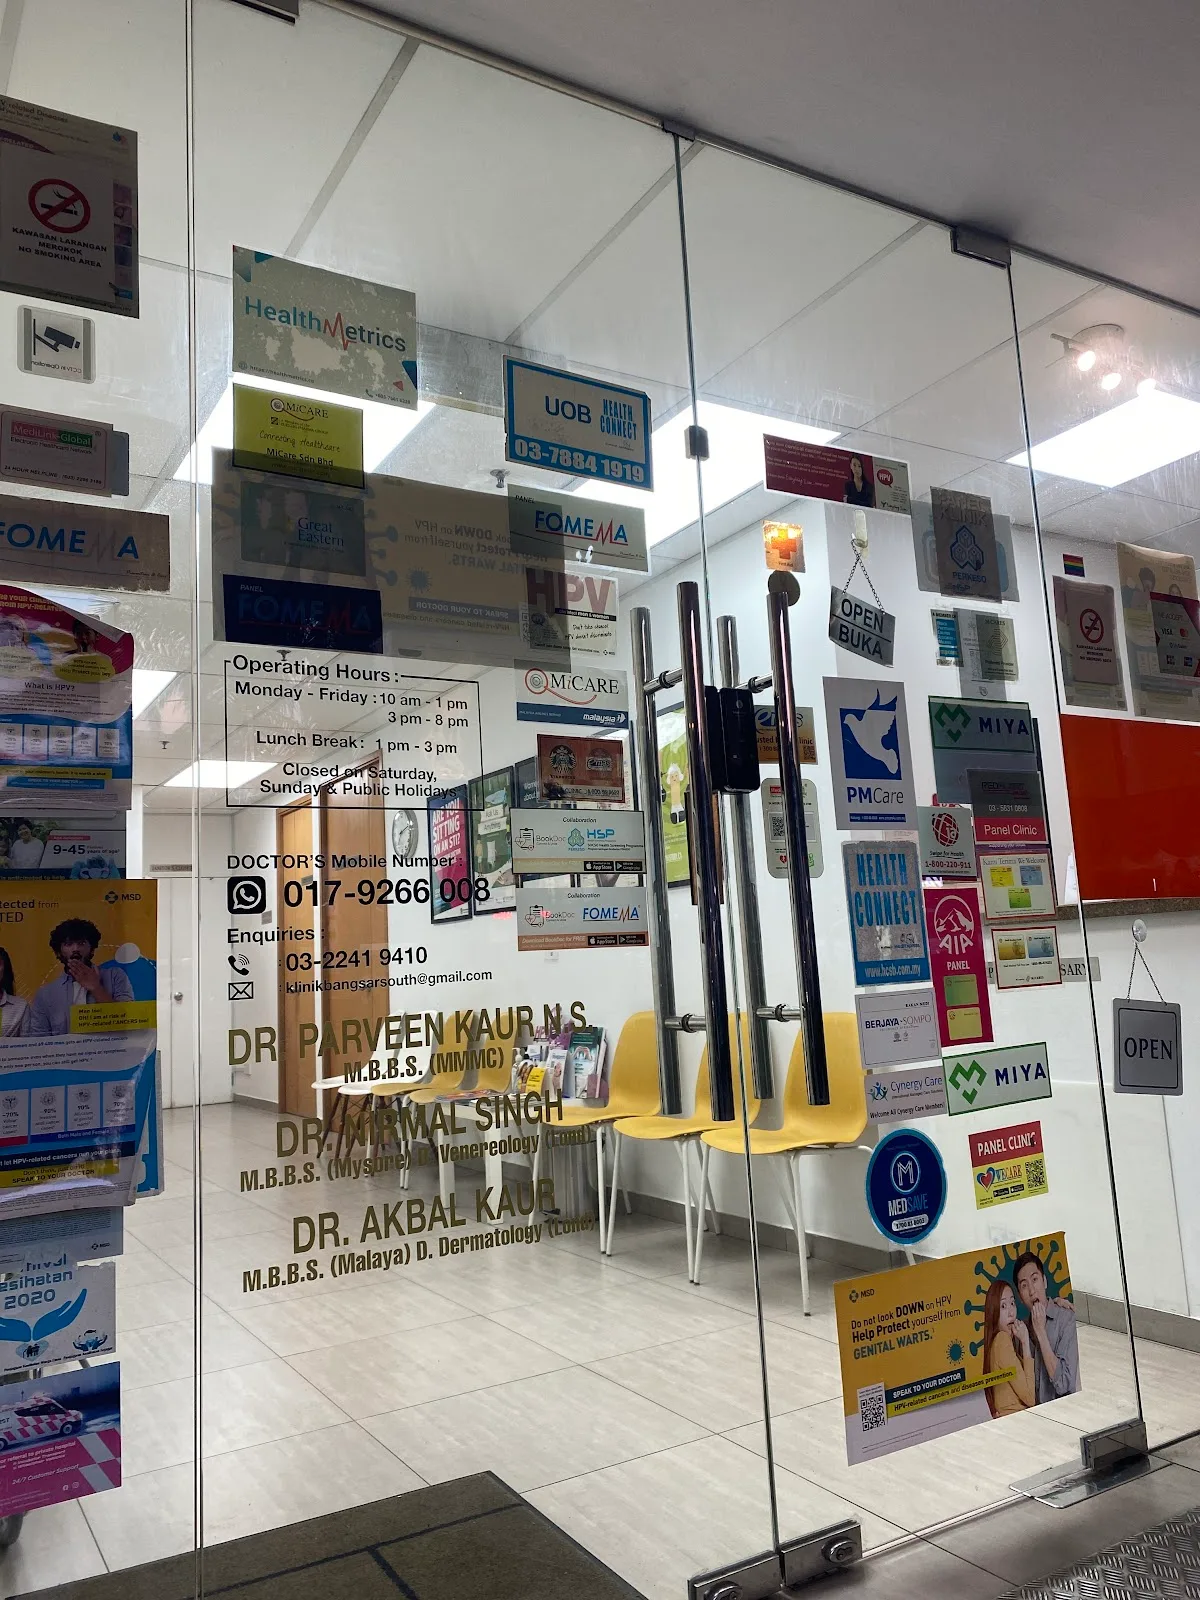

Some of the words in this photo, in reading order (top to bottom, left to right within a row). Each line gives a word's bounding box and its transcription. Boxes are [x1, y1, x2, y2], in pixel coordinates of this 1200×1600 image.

[12, 227, 57, 242] KAWASAN
[60, 237, 107, 252] LARANGAN
[38, 241, 83, 256] MEROKOK
[18, 245, 32, 254] NO
[34, 249, 76, 264] SMOKING
[79, 258, 102, 268] AREA
[545, 395, 592, 424] UOB
[602, 398, 634, 422] HEALTH
[600, 415, 637, 440] CONNECT
[266, 447, 296, 460] MiCare
[300, 453, 315, 463] Sdn
[318, 456, 333, 467] Bhd
[515, 439, 598, 473] 03-7884
[601, 459, 645, 483] 1919
[878, 472, 891, 482] HPV
[515, 494, 536, 504] PANEL
[297, 517, 333, 534] Great
[535, 510, 629, 546] FOMEMA
[298, 529, 345, 547] Eastern
[240, 583, 264, 593] PANEL
[952, 571, 987, 584] PERKESO
[841, 598, 884, 634] OPEN
[838, 623, 884, 660] BUKA
[232, 654, 329, 681] Operating
[25, 682, 45, 690] What
[54, 684, 75, 692] HPV?
[550, 672, 620, 695] MiCARE
[235, 681, 303, 699] Monday
[400, 696, 421, 707] am
[436, 697, 442, 708] 1
[448, 700, 468, 711] pm
[388, 712, 397, 723] 3
[400, 714, 422, 726] pm
[435, 714, 443, 726] 8
[448, 716, 469, 728] pm
[583, 713, 616, 724] malaysia
[978, 716, 1030, 736] MIYA
[256, 730, 307, 747] Lunch
[376, 738, 382, 750] 1
[388, 741, 410, 753] pm
[424, 741, 433, 753] 3
[436, 743, 457, 755] pm
[283, 763, 340, 778] Closed
[345, 767, 364, 778] on
[368, 766, 437, 783] Saturday,
[260, 779, 322, 796] Sunday
[327, 783, 337, 795] &
[343, 782, 390, 796] Public
[395, 784, 457, 801] Holidays
[846, 786, 904, 804] PMCare
[433, 808, 445, 825] ARE
[445, 799, 460, 815] YOU
[433, 815, 461, 845] SITTING
[587, 828, 615, 839] HSP
[984, 824, 1011, 836] Panel
[1012, 825, 1038, 836] Clinic
[53, 844, 86, 855] 9-45
[227, 855, 326, 869] DOCTOR'S
[331, 855, 387, 869] Mobile
[856, 854, 908, 886] HEALTH
[925, 861, 972, 869] 1-800-220-911
[121, 893, 141, 901] MSD
[284, 878, 431, 908] 017-9266
[439, 877, 491, 903] 008
[582, 904, 640, 923] FOMEMA
[854, 889, 918, 927] CONNECT
[939, 933, 974, 955] AIA
[286, 949, 371, 972] 03-2241
[379, 946, 428, 966] 9410
[946, 961, 971, 972] PANEL
[286, 970, 493, 994] klinikbangsarsouth@gmail.com
[299, 1012, 444, 1059] PARVEEN
[455, 1005, 535, 1044] KAUR
[544, 1001, 595, 1035] N.S.
[865, 1016, 900, 1030] BERJAYA
[903, 1013, 932, 1026] SOMPO
[1124, 1037, 1173, 1060] OPEN
[344, 1057, 423, 1084] M.B.B.S.
[430, 1047, 504, 1076] (MMMC)
[994, 1062, 1047, 1087] MIYA
[890, 1079, 923, 1093] Cynergy
[924, 1076, 943, 1087] Care
[276, 1115, 333, 1158] DR.
[345, 1102, 466, 1148] NIRMAL
[475, 1088, 564, 1132] SINGH
[869, 1110, 890, 1120] Welcome
[897, 1107, 914, 1117] Cynergy
[914, 1105, 925, 1113] Care
[12, 1155, 51, 1165] HPV-related
[52, 1153, 78, 1161] cancers
[240, 1162, 321, 1193] M.B.B.S.
[327, 1150, 413, 1182] (Mysore)
[418, 1146, 438, 1167] D.
[440, 1131, 541, 1164] Venereology
[546, 1124, 592, 1152] (Lond)
[978, 1141, 1006, 1156] PANEL
[12, 1176, 34, 1184] SPEAK
[47, 1172, 66, 1180] YOUR
[68, 1169, 95, 1177] DOCTOR
[293, 1210, 350, 1254] DR.
[360, 1192, 467, 1244] AKBAL
[475, 1178, 557, 1222] KAUR
[887, 1193, 929, 1217] MEDSAVE
[242, 1259, 324, 1293] M.B.B.S.
[330, 1243, 411, 1279] (Malaya)
[416, 1240, 434, 1262] D.
[438, 1223, 543, 1257] Dermatology
[548, 1212, 595, 1239] (Lond)
[4, 1288, 56, 1310] 2020
[860, 1288, 875, 1298] MSD
[851, 1319, 862, 1330] Do
[863, 1316, 876, 1327] not
[877, 1311, 894, 1324] look
[896, 1301, 925, 1319] DOWN
[926, 1302, 935, 1310] on
[936, 1294, 952, 1307] HPV
[852, 1328, 875, 1344] Help
[876, 1320, 911, 1338] Protect
[912, 1310, 943, 1329] yourself
[944, 1307, 961, 1319] from
[853, 1340, 895, 1360] GENITAL
[892, 1388, 912, 1399] SPEAK
[913, 1386, 921, 1394] TO
[922, 1380, 938, 1392] YOUR
[938, 1373, 962, 1387] DOCTOR
[894, 1396, 927, 1411] HPV-related
[928, 1389, 950, 1402] cancers
[951, 1386, 961, 1395] and
[961, 1380, 985, 1391] diseases
[12, 1476, 26, 1485] 24/7
[28, 1469, 55, 1481] Customer
[56, 1463, 80, 1475] Support
